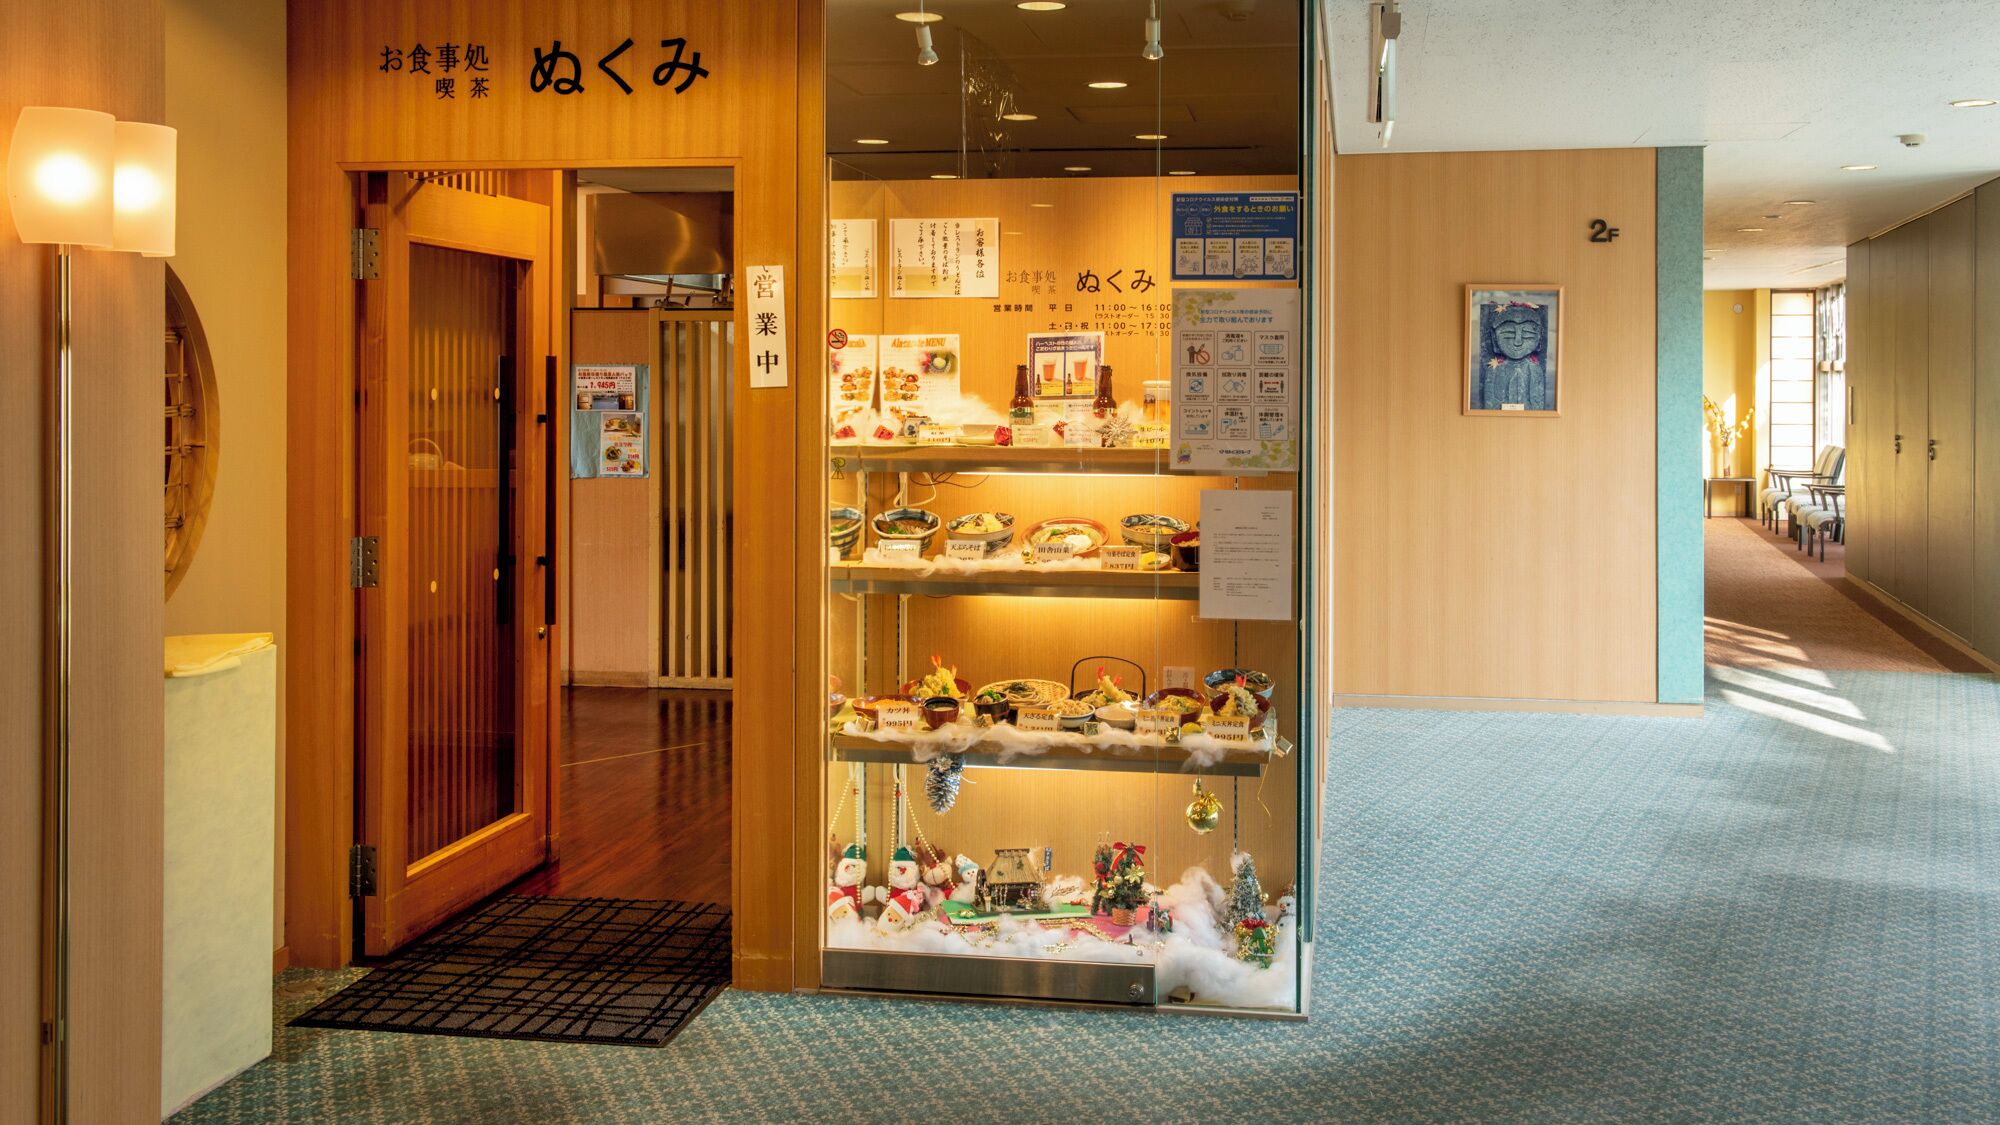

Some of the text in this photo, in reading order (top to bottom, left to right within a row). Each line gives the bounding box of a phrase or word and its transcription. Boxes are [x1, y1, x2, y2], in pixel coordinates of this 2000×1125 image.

[379, 42, 490, 75] お食事処
[529, 37, 710, 96] ぬくみ
[435, 77, 490, 99] 喫茶
[1213, 204, 1294, 214] 外食をするときのお願い
[1589, 219, 1620, 243] 2F
[975, 228, 985, 279] お客様各位
[1005, 269, 1057, 284] お食事処
[1076, 268, 1156, 294] ぬくみ
[1031, 285, 1057, 295] 喫茶
[993, 303, 1034, 313] 営業時間
[1048, 303, 1074, 312] 平日
[753, 274, 779, 374] 営業中
[1212, 720, 1244, 728] ミニ天丼定食
